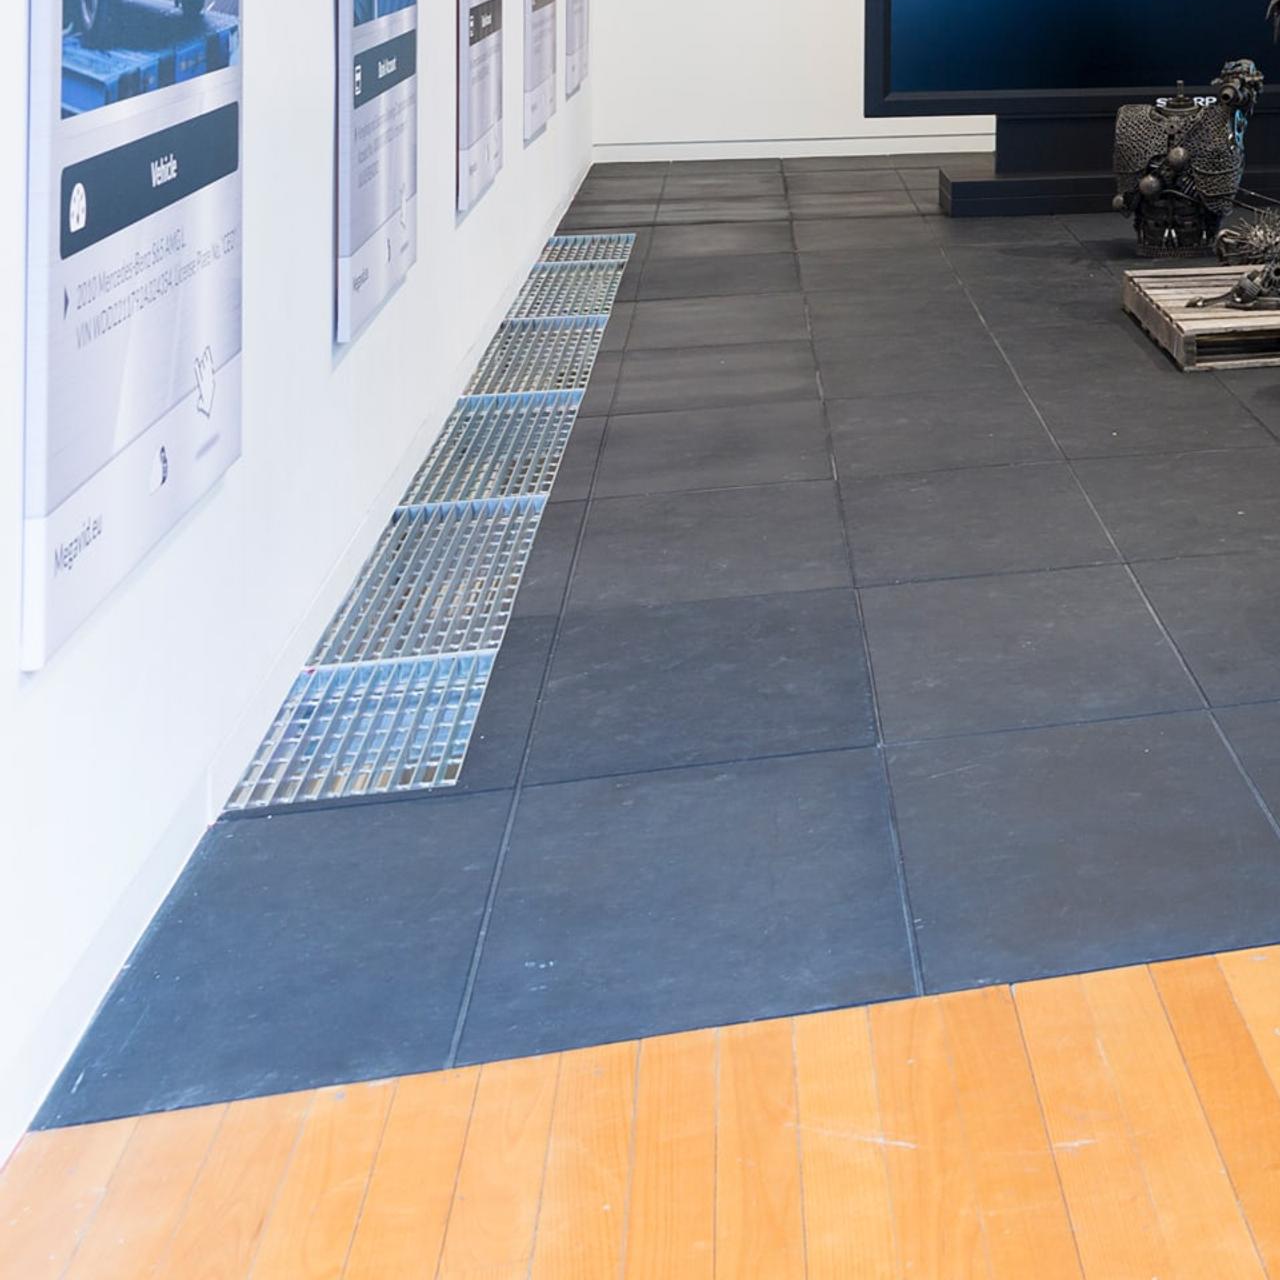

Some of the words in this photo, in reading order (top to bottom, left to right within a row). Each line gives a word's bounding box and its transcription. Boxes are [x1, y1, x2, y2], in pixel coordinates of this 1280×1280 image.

[1156, 96, 1217, 108] SRP
[150, 153, 178, 188] Vehicle
[53, 515, 103, 580] Megavid.eu
